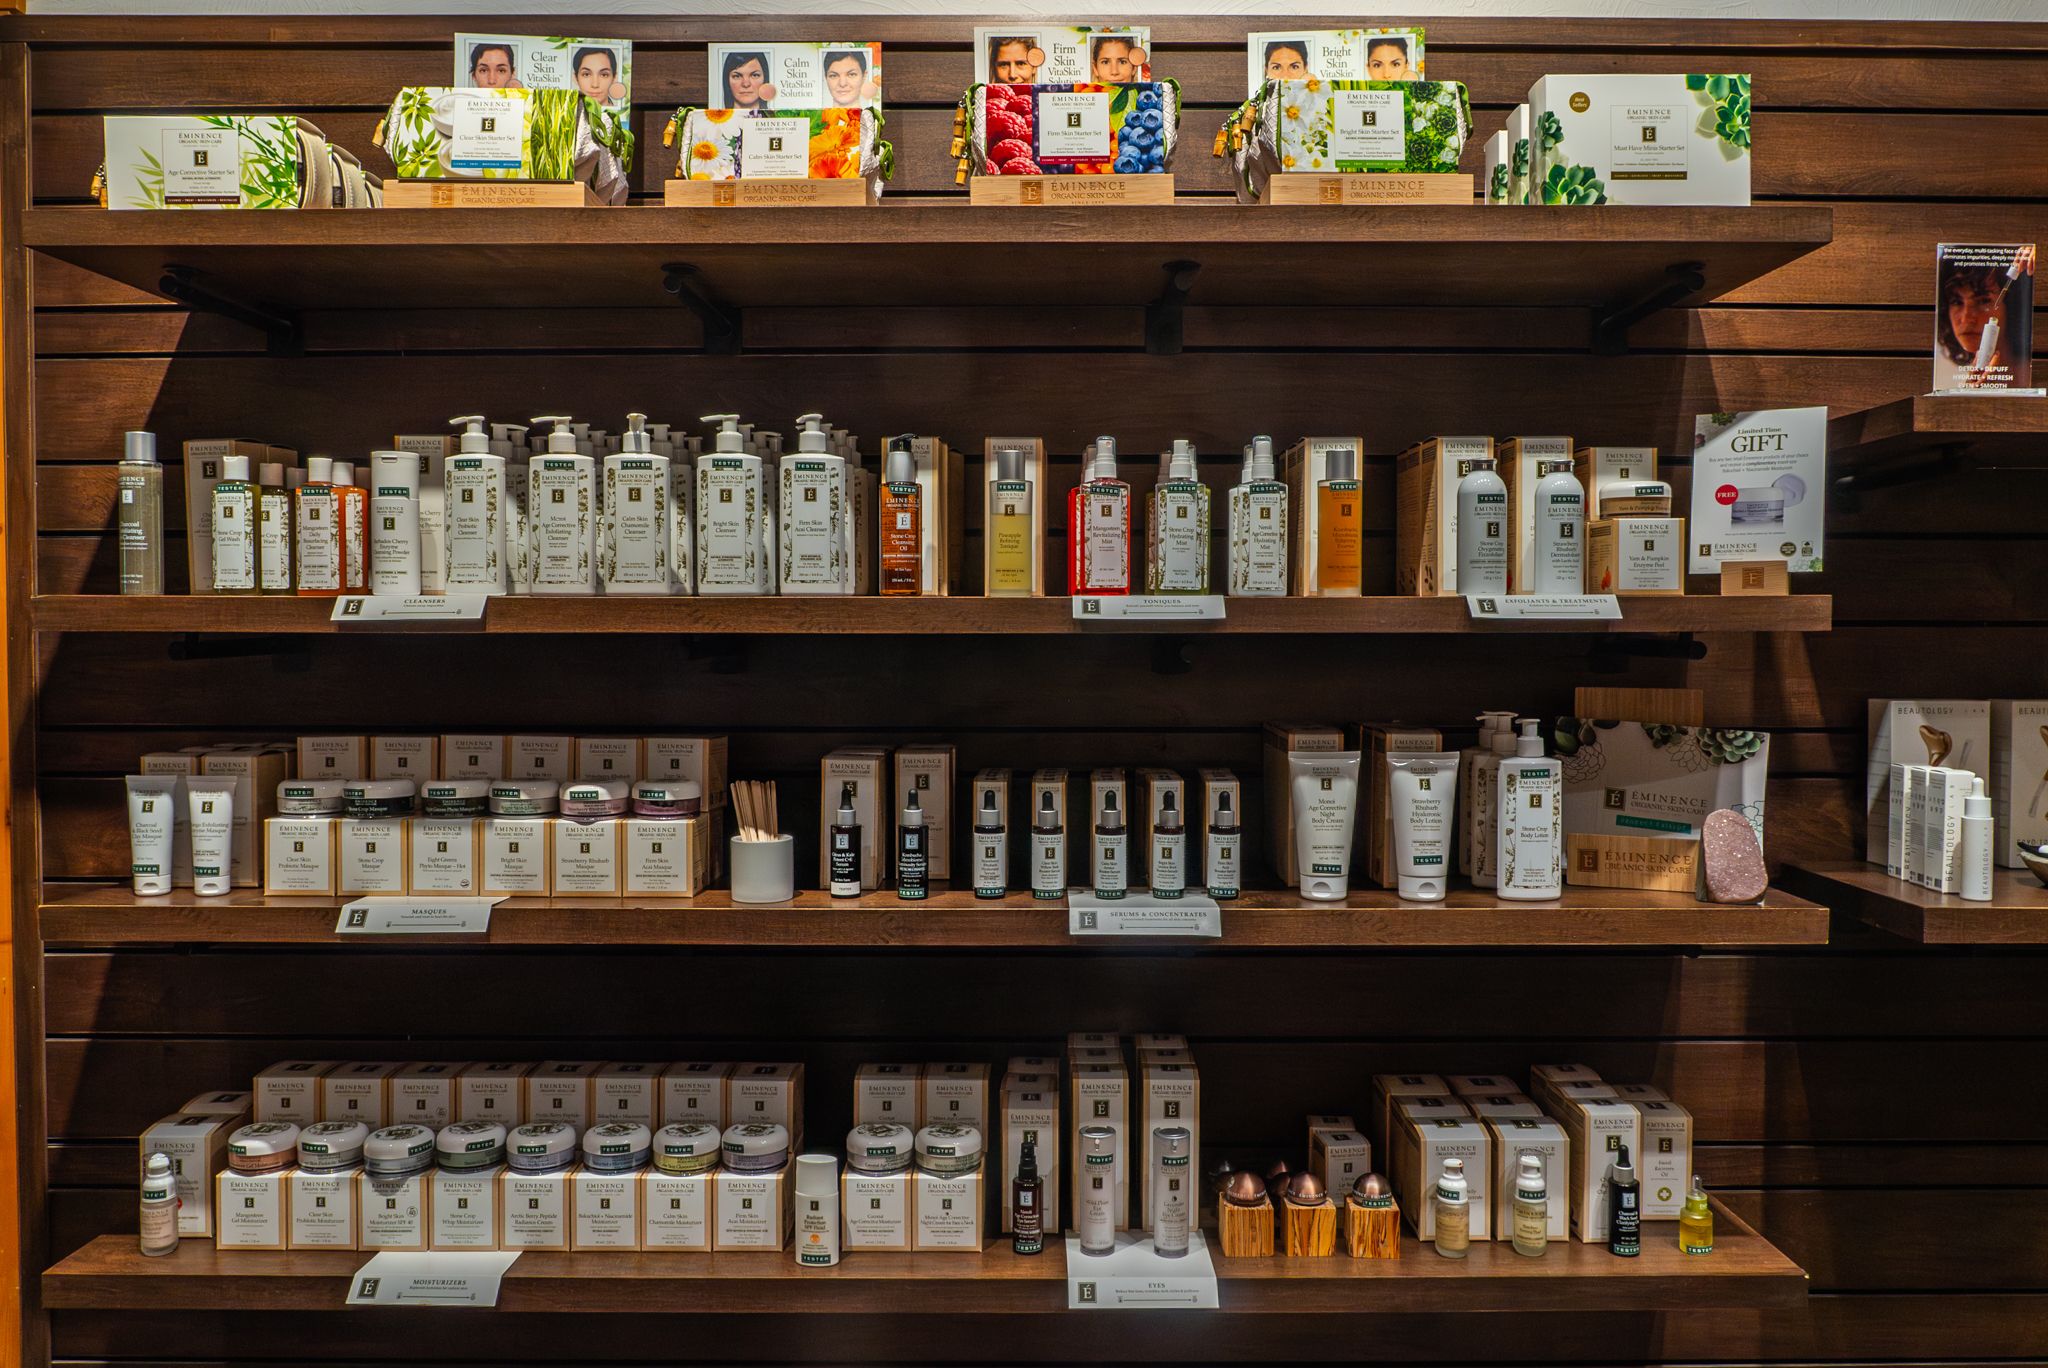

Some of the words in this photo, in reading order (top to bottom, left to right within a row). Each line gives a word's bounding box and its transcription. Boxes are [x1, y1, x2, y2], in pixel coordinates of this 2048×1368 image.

[1054, 43, 1076, 54] Firm
[1322, 46, 1351, 58] Bright
[531, 52, 557, 63] Clear
[1054, 56, 1075, 66] Skin
[534, 63, 554, 73] Skin
[784, 58, 809, 68] Calm
[1326, 59, 1347, 68] Skin
[786, 69, 807, 79] Skin
[780, 89, 813, 98] Solution
[1731, 434, 1788, 453] GIFT
[1898, 707, 1954, 715] BEAUTOLOGY
[1946, 815, 1955, 882] BEAUTOLOGY
[1605, 863, 1644, 872] ORGANIC
